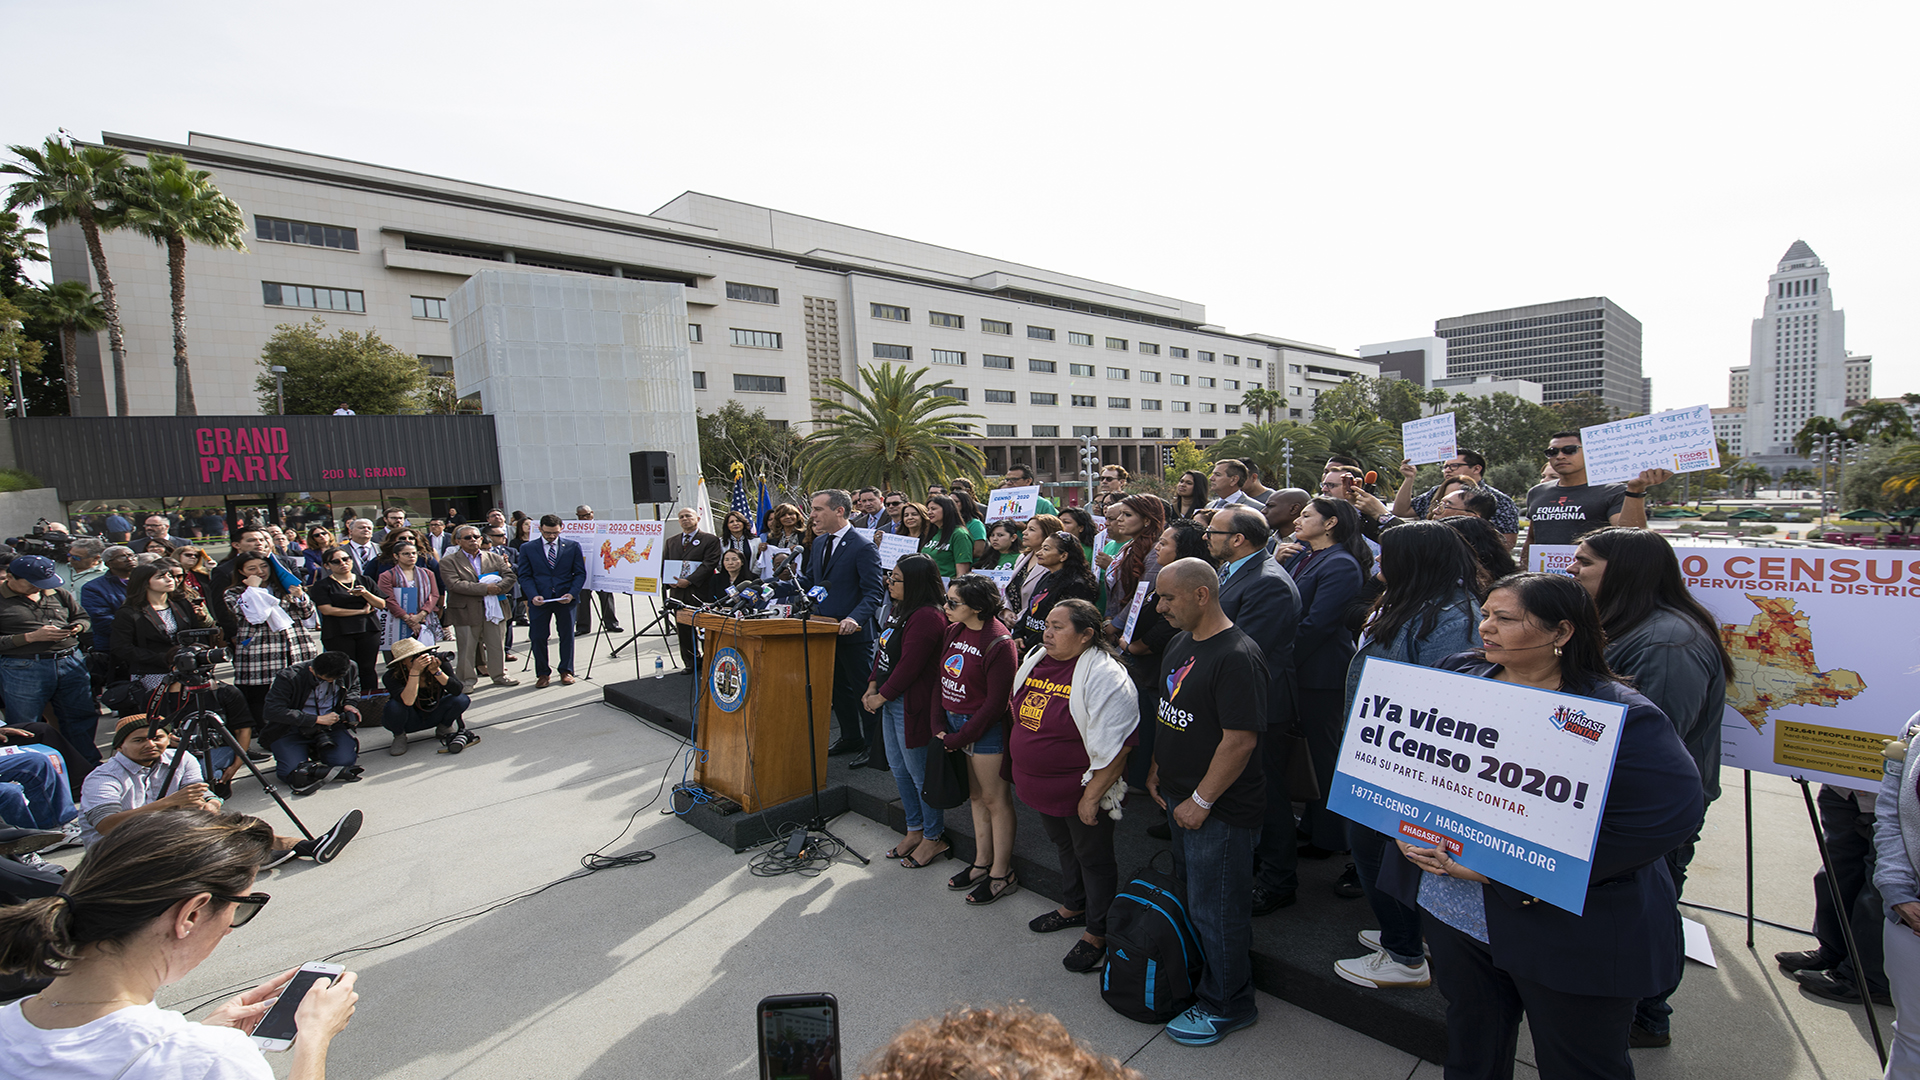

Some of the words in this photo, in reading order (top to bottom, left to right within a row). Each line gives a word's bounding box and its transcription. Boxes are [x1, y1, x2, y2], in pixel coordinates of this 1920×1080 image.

[196, 427, 289, 455] GRAND
[1648, 426, 1710, 445] 全員が数える
[1679, 451, 1707, 459] TODOS
[199, 455, 293, 483] PARK
[322, 469, 345, 479] 200
[348, 468, 361, 478] N.
[365, 467, 407, 478] GRAND
[1532, 512, 1586, 521] CALIFORNIA
[1537, 505, 1581, 514] EQUALITY
[567, 523, 596, 531] CENSU
[609, 523, 628, 532] 2020
[629, 523, 662, 533] CENSUS
[1830, 583, 1920, 598] DISTRIC
[941, 676, 966, 695] CHIRLA
[1359, 694, 1404, 724] ¡Ya
[1409, 707, 1500, 749] viene
[1564, 721, 1600, 741] CONTAR
[1569, 713, 1605, 733] HÁGASE
[1783, 732, 1836, 745] hard-to-survey
[1838, 740, 1866, 749] Census
[1784, 725, 1816, 735] 732,641
[1818, 730, 1851, 740] PEOPLE
[1783, 743, 1810, 751] Median
[1811, 746, 1850, 758] household
[1852, 754, 1882, 763] income:
[1360, 724, 1385, 748] el
[1388, 730, 1472, 774] Censo
[1477, 755, 1589, 810] 2020!
[1783, 754, 1805, 762] Below
[1806, 758, 1834, 768] poverty
[1858, 766, 1883, 775] 15.4%
[1354, 750, 1377, 766] HAGA
[1379, 759, 1392, 771] SU
[1393, 763, 1428, 783] PARTE.
[1431, 775, 1474, 799] HÁGASE
[1476, 790, 1530, 818] CONTAR.
[1350, 784, 1420, 819] 1-877-EL-CENSO
[1435, 814, 1557, 873] HAGASECONTAR.ORG
[1402, 824, 1461, 853] #HAGASECTAR
